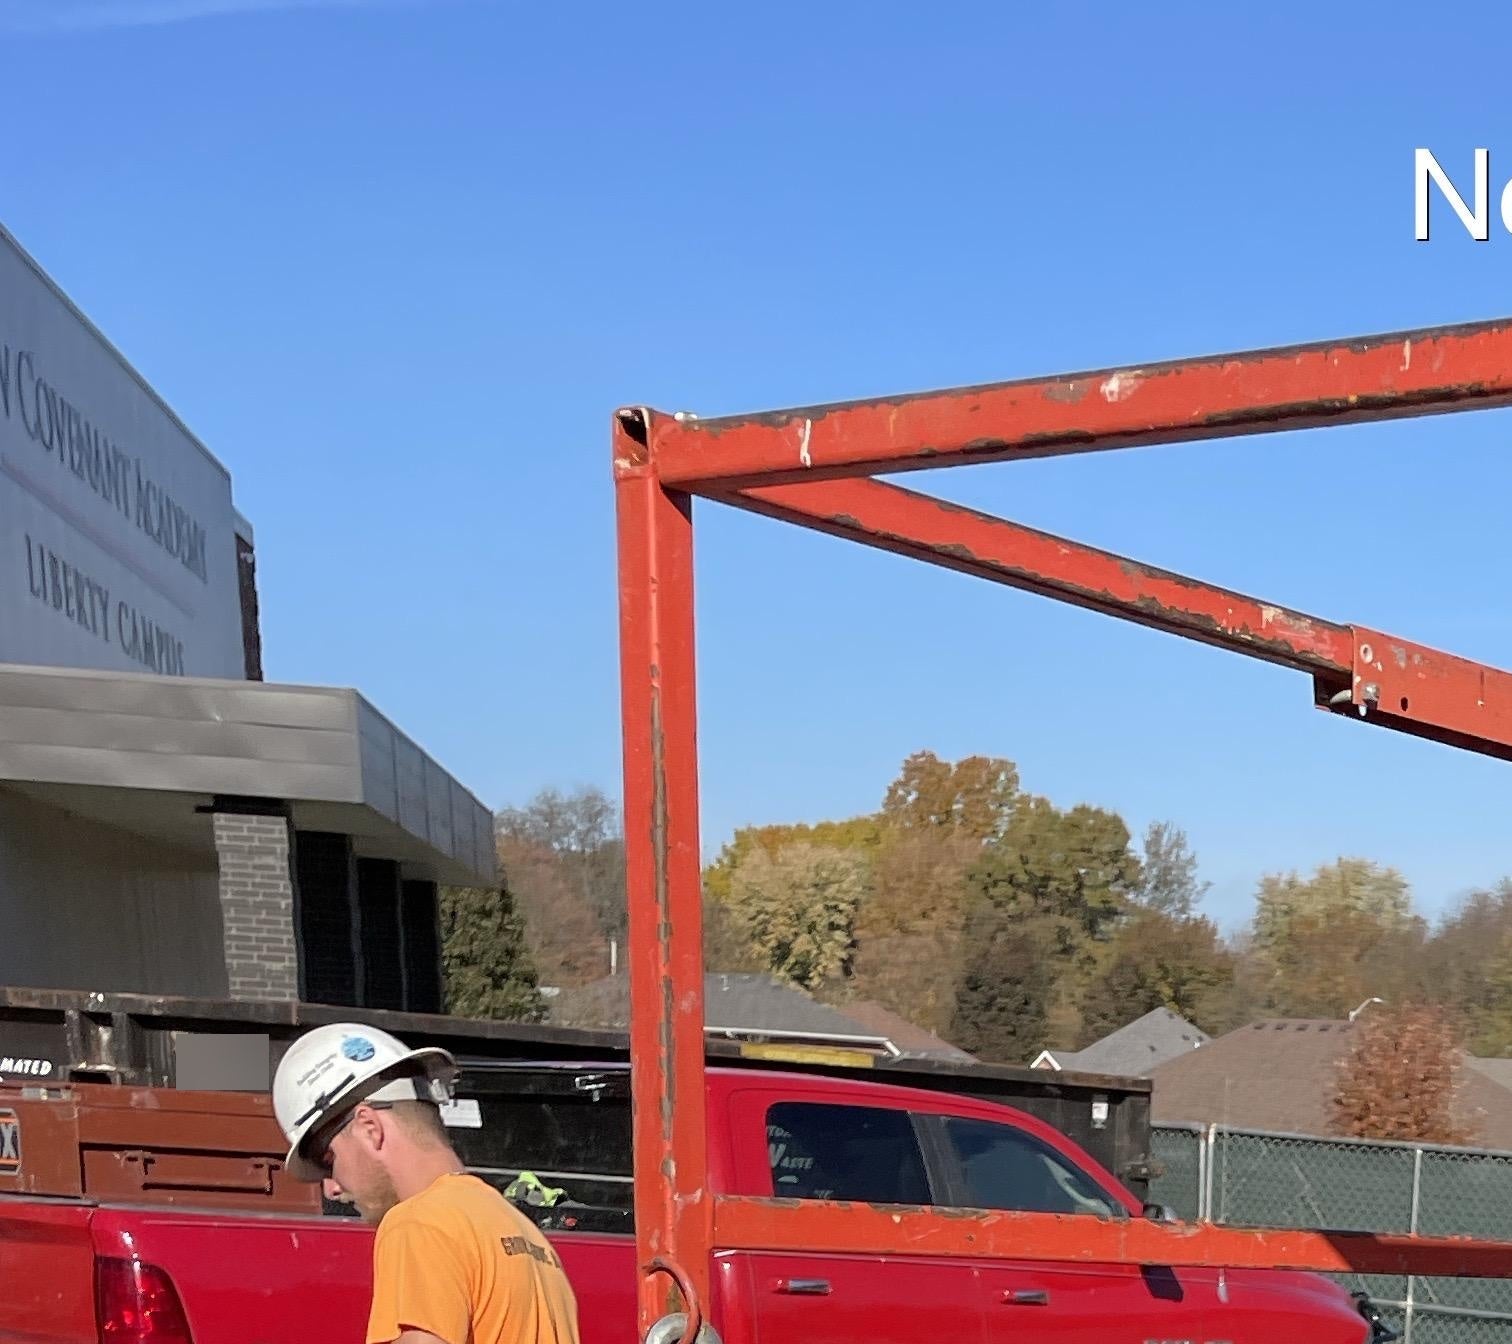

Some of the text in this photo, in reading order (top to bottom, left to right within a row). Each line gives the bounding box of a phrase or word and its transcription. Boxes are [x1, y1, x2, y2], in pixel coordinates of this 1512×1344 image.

[18, 349, 131, 521] COVENANT
[134, 457, 208, 585] ACADEMY
[25, 532, 185, 677] LIBERTY CAMPUS
